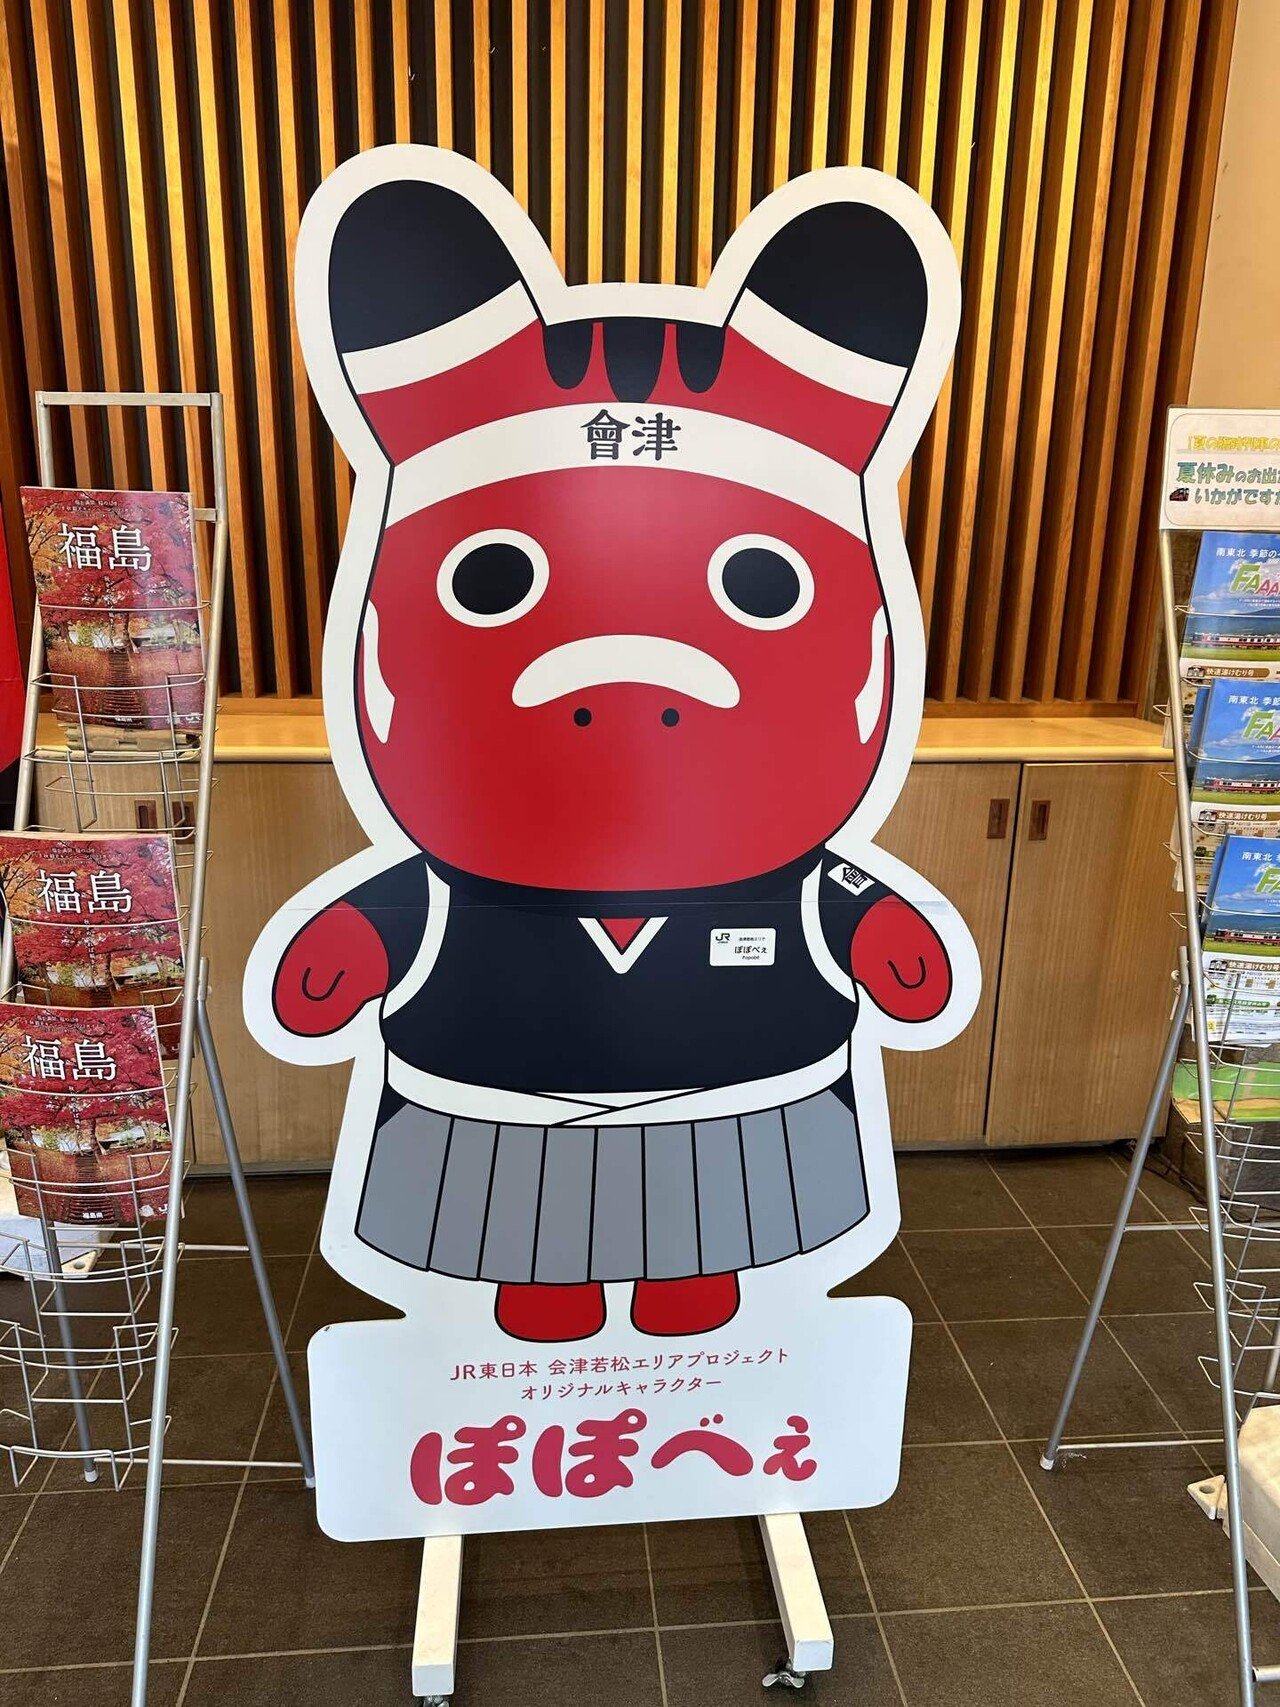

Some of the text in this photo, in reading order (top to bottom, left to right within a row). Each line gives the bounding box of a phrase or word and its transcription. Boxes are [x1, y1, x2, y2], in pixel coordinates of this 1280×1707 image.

[580, 409, 682, 461] 會津
[58, 523, 152, 571] 福島
[1216, 547, 1246, 558] 南東北
[1230, 563, 1280, 596] FAAA
[1228, 695, 1259, 705] 南東北
[1242, 851, 1273, 862] 南東北
[38, 869, 132, 914] 福島
[715, 932, 731, 942] JR
[22, 1034, 118, 1081] 福島
[450, 1348, 788, 1381] JR東日本 会津若松エリアプロジェクト
[521, 1376, 722, 1400] オリジナルキャラクター
[410, 1408, 818, 1506] ぽぽべぇ
